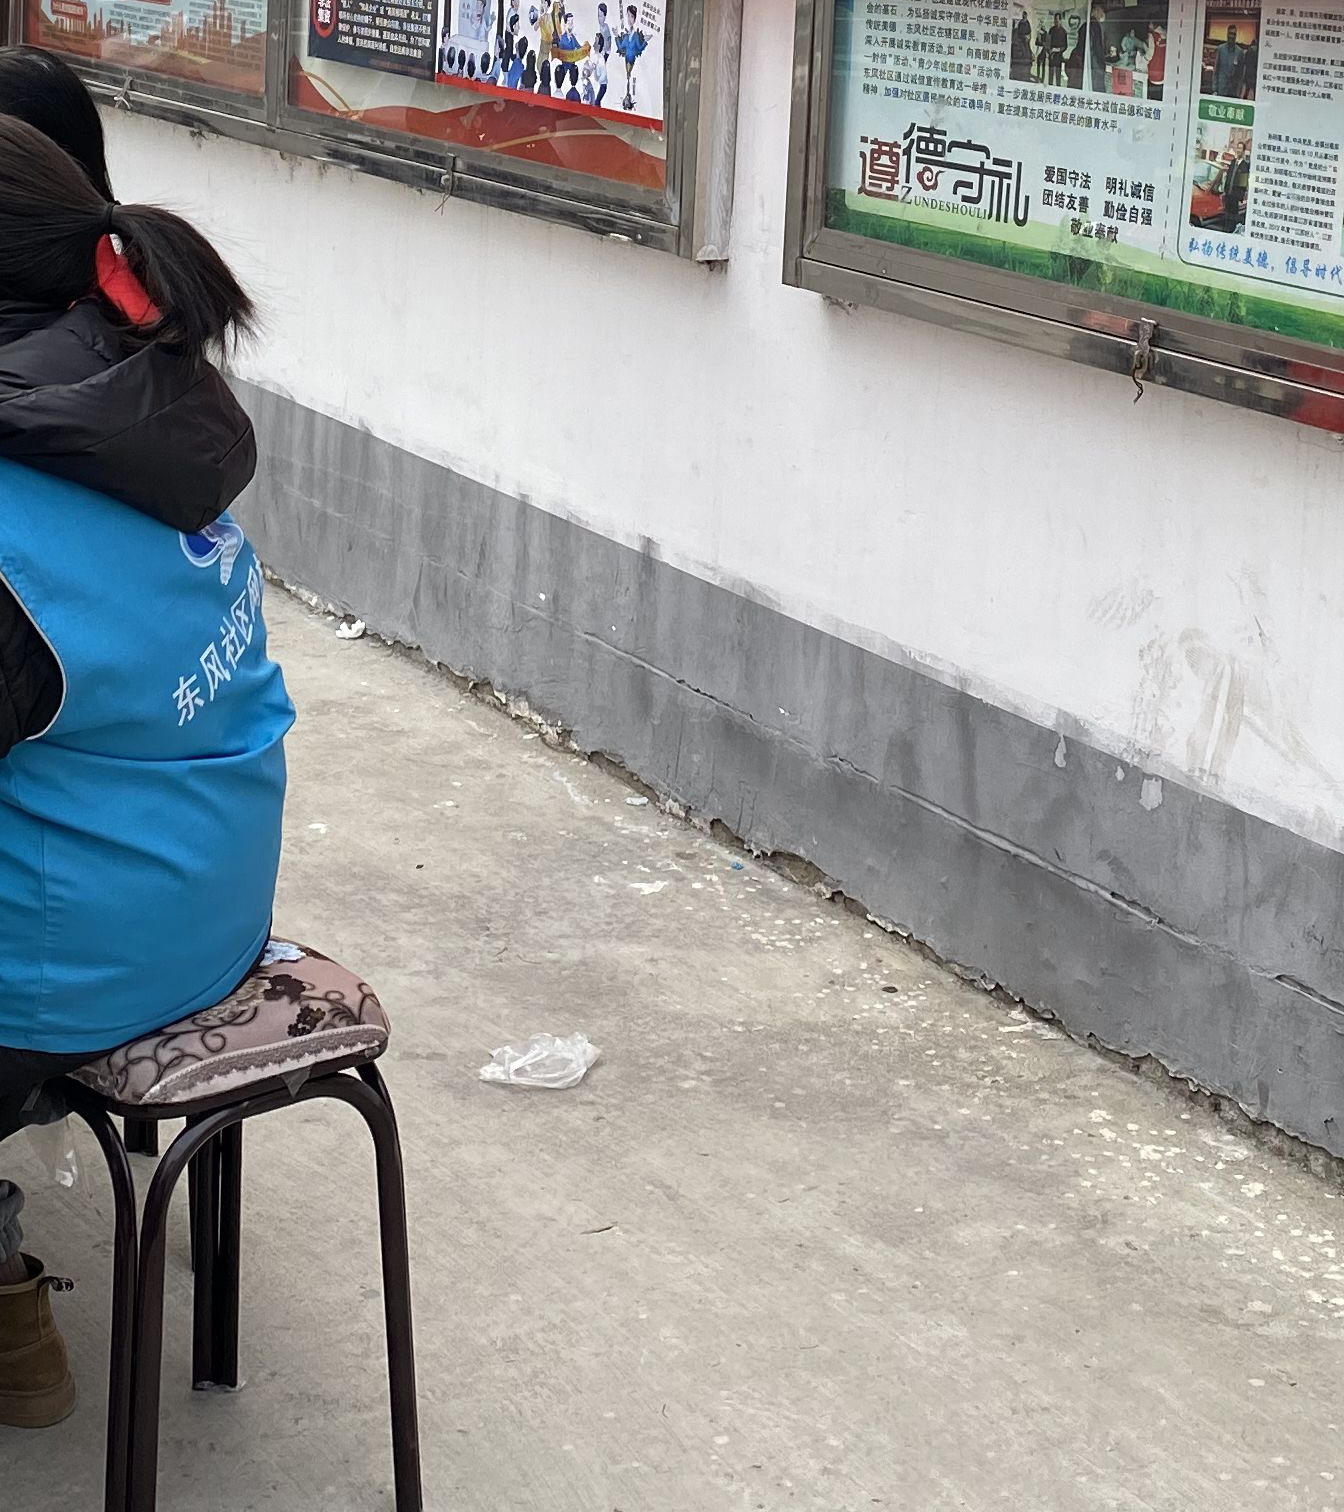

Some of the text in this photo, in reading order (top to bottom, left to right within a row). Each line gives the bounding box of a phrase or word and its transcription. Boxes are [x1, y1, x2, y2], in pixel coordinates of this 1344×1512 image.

[857, 122, 1030, 227] 遵德守礼
[1044, 165, 1156, 203] 爱国守法 明礼诚信
[900, 185, 988, 220] ZUNDESHOULI
[1042, 188, 1154, 227] 团结友善 勤俭自强
